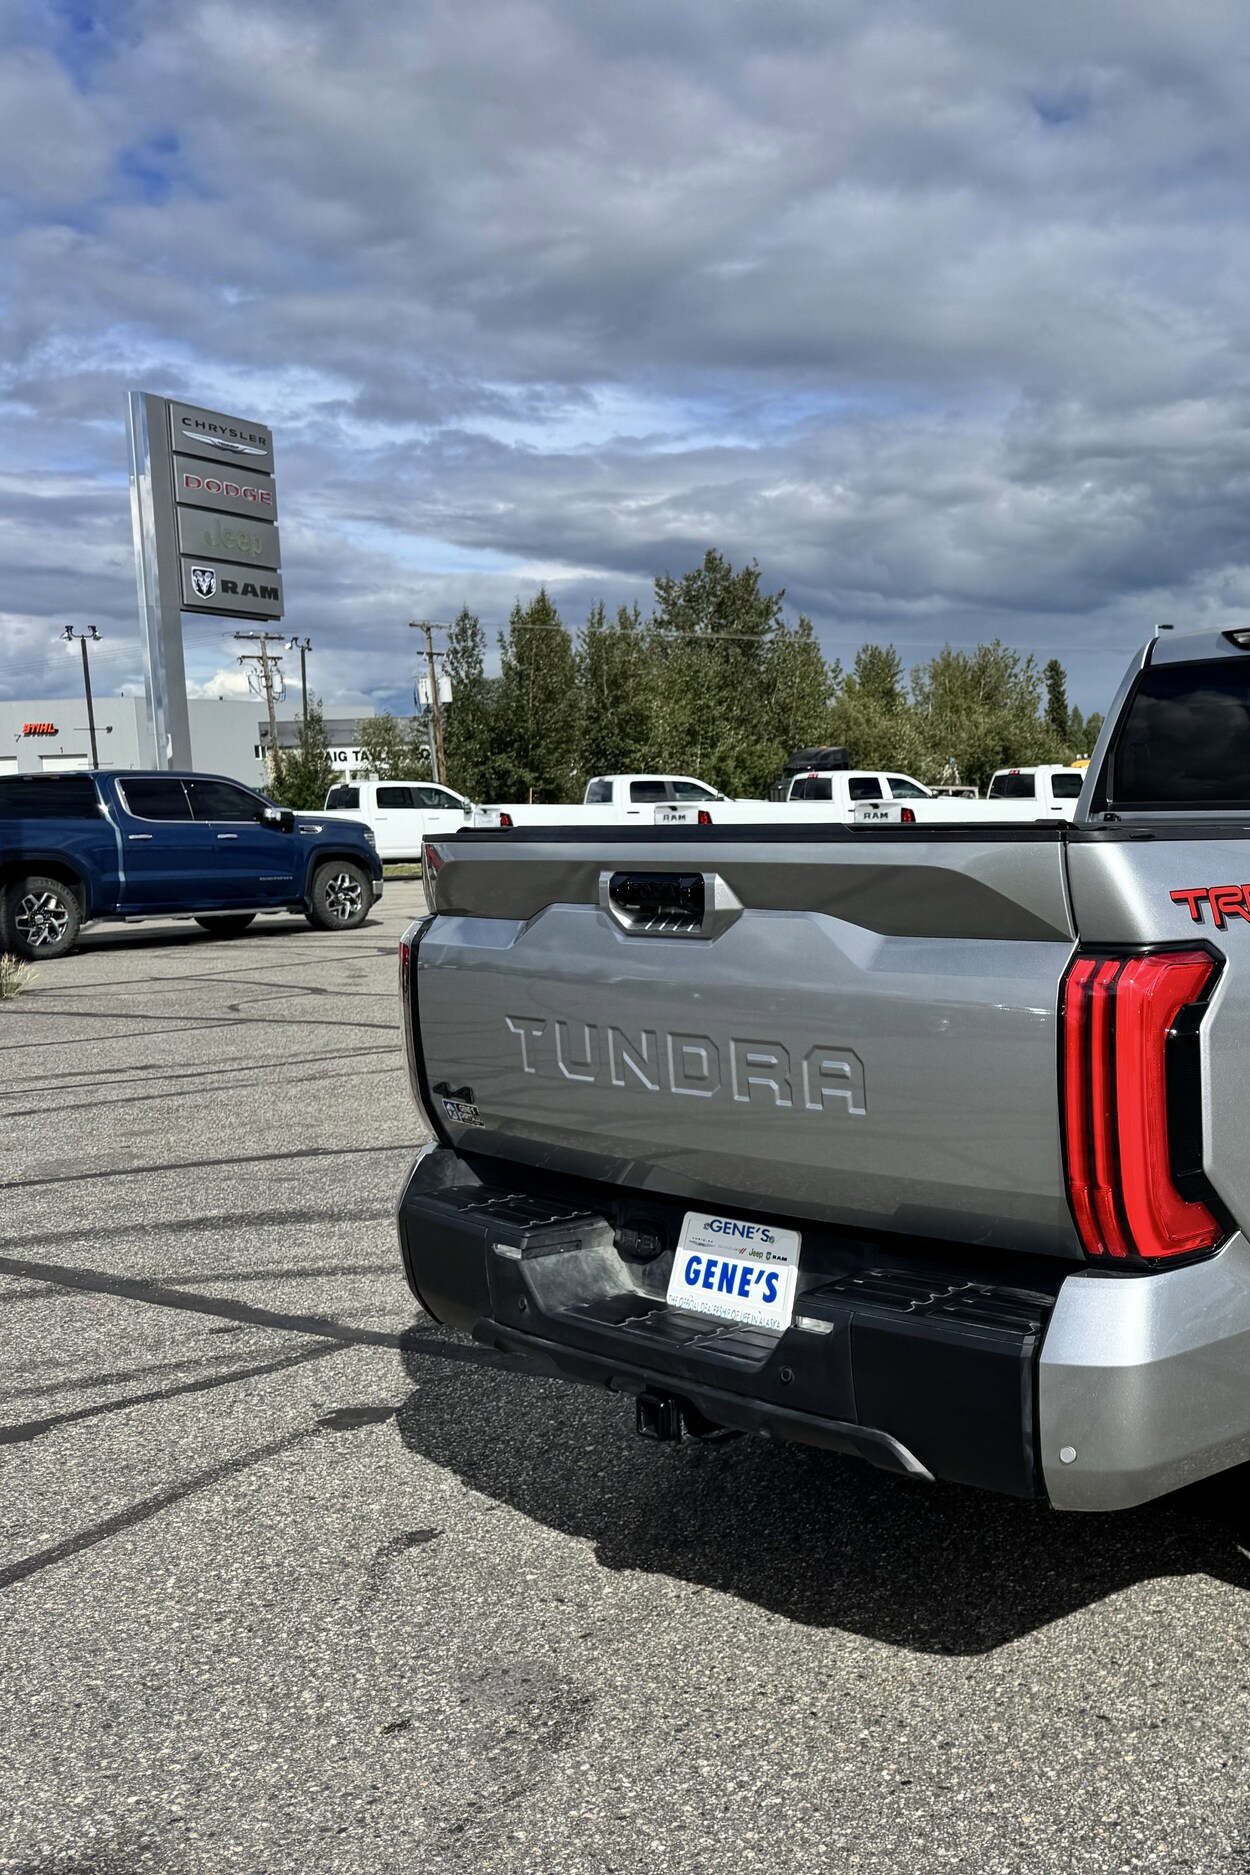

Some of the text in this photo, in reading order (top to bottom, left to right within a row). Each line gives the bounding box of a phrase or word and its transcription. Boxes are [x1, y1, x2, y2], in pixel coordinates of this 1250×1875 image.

[181, 417, 267, 446] CHRYSLER
[183, 473, 273, 506] DODGE
[203, 518, 264, 559] Jeep
[220, 578, 279, 601] RAM
[22, 723, 58, 736] STIHL
[325, 750, 348, 762] AIG
[504, 1013, 868, 1116] TUNDRA
[709, 1219, 771, 1243] GENE'S
[748, 1248, 764, 1259] Jeep
[772, 1254, 788, 1262] RAM
[684, 1255, 780, 1304] GENE'S
